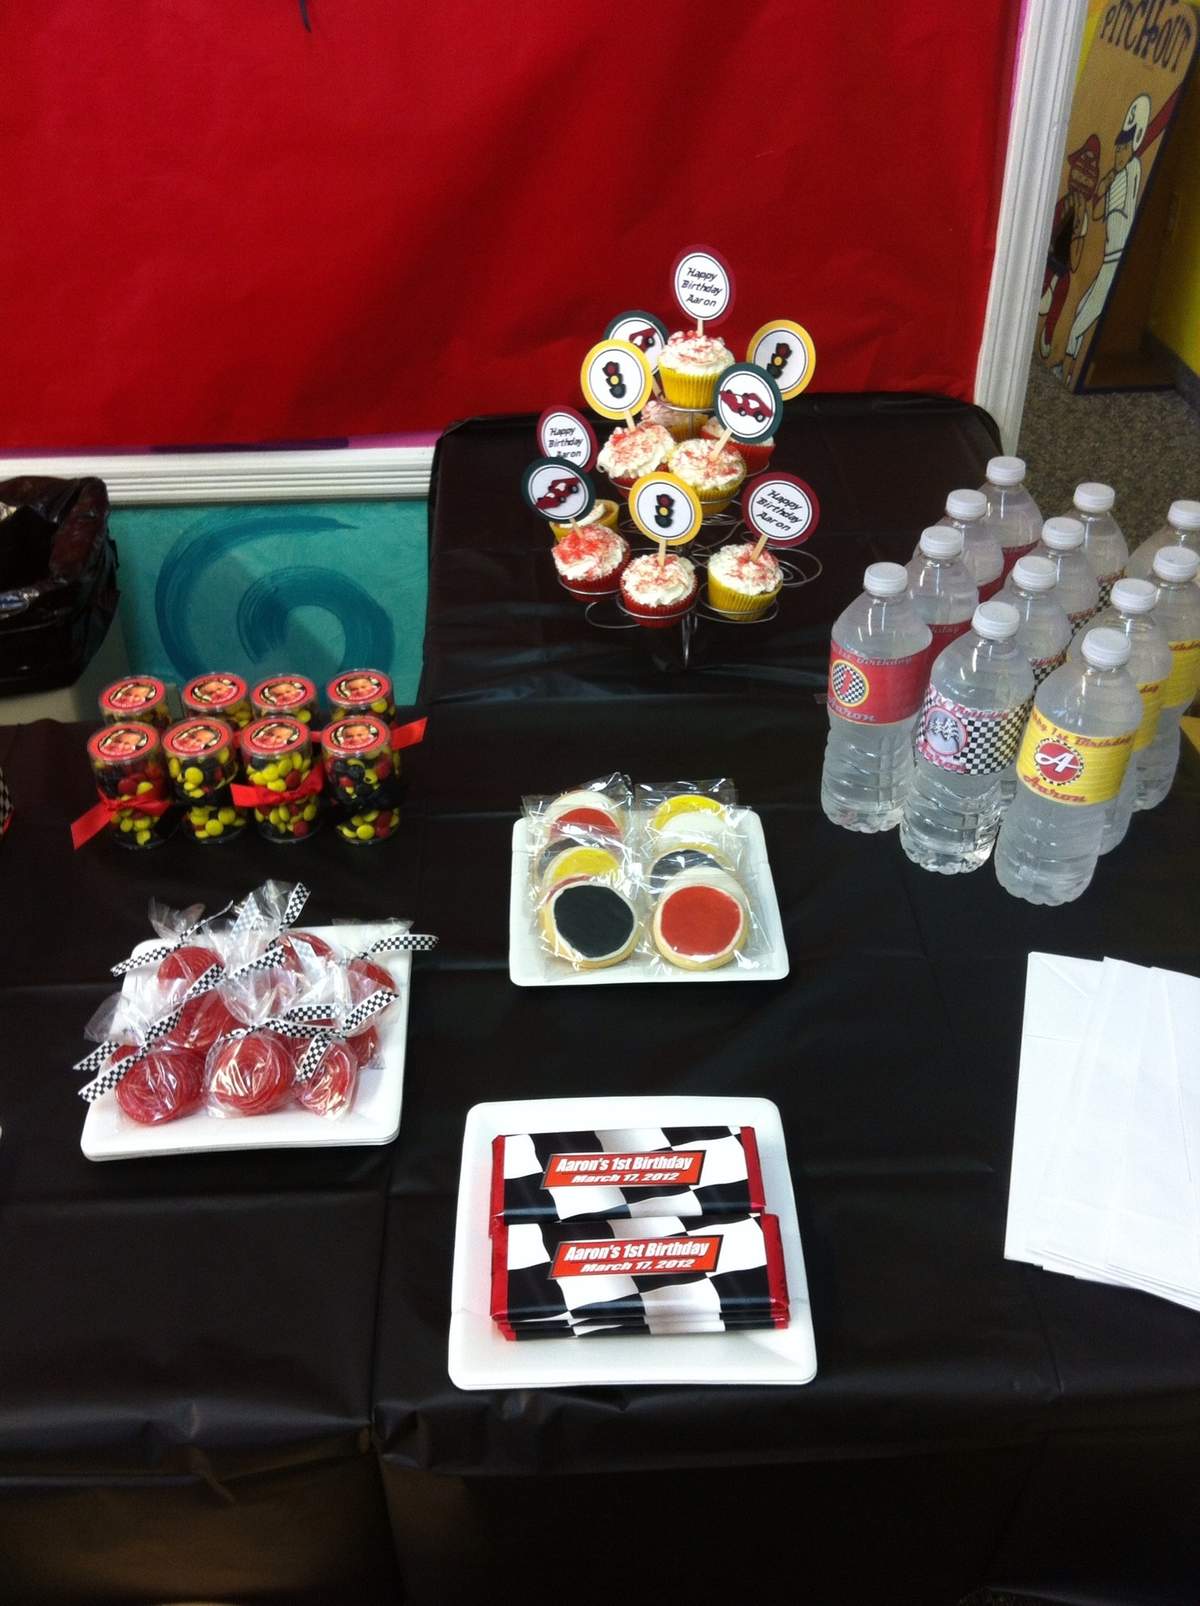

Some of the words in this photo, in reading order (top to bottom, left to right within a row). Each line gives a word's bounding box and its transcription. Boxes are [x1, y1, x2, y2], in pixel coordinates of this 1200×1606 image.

[687, 267, 718, 282] Happy
[681, 280, 722, 296] Birthday
[687, 294, 716, 307] Aaron
[550, 427, 576, 437] Happy
[548, 437, 583, 448] Birthday
[767, 489, 802, 510] Happy
[756, 497, 802, 523] Birthday
[756, 511, 791, 531] Aaron
[555, 1157, 610, 1173] Aaron's
[612, 1156, 631, 1171] 1st
[633, 1156, 694, 1171] Birthday
[571, 1174, 621, 1184] March
[643, 1172, 680, 1181] 2012
[563, 1243, 622, 1262] Aaron's
[624, 1243, 646, 1259] 1st
[646, 1242, 711, 1258] Birthday
[579, 1263, 632, 1274] March
[655, 1259, 696, 1270] 2012
